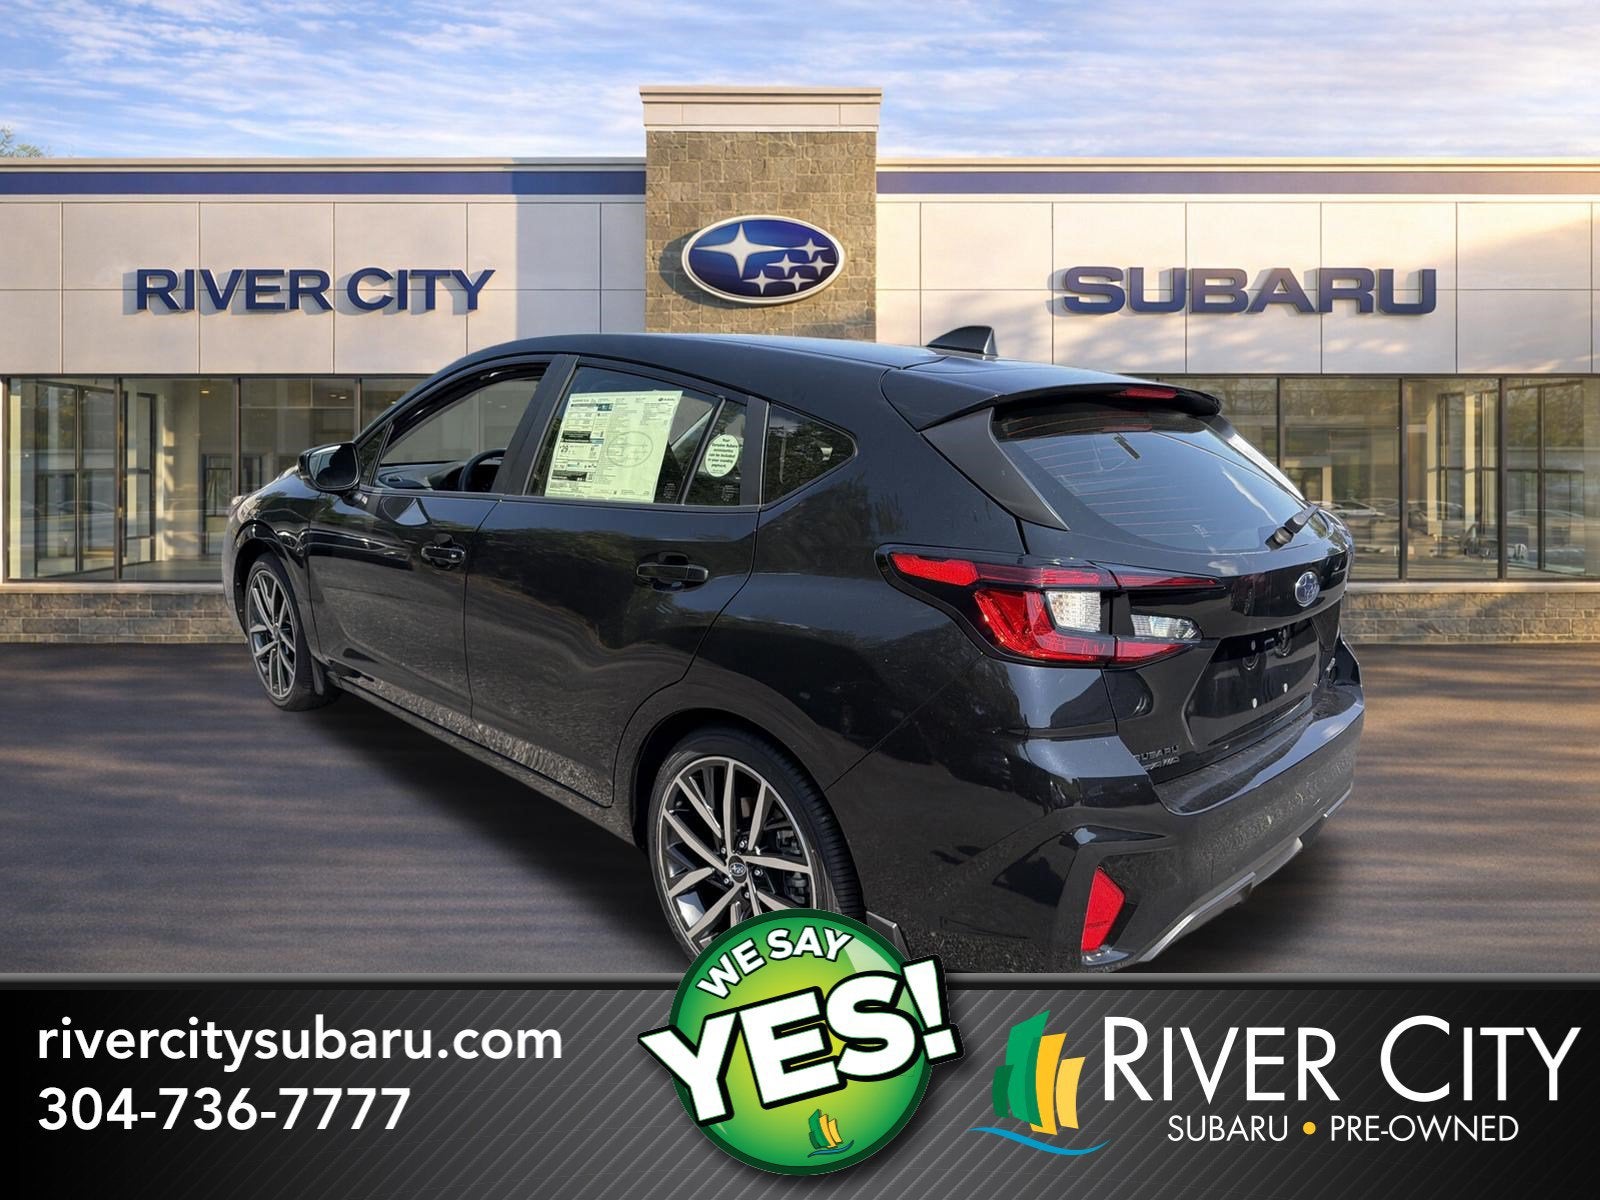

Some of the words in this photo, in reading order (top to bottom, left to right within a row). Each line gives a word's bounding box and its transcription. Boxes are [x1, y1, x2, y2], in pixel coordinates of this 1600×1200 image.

[136, 268, 335, 311] RIVER
[345, 267, 496, 311] CITY
[1063, 266, 1437, 314] SUBARU
